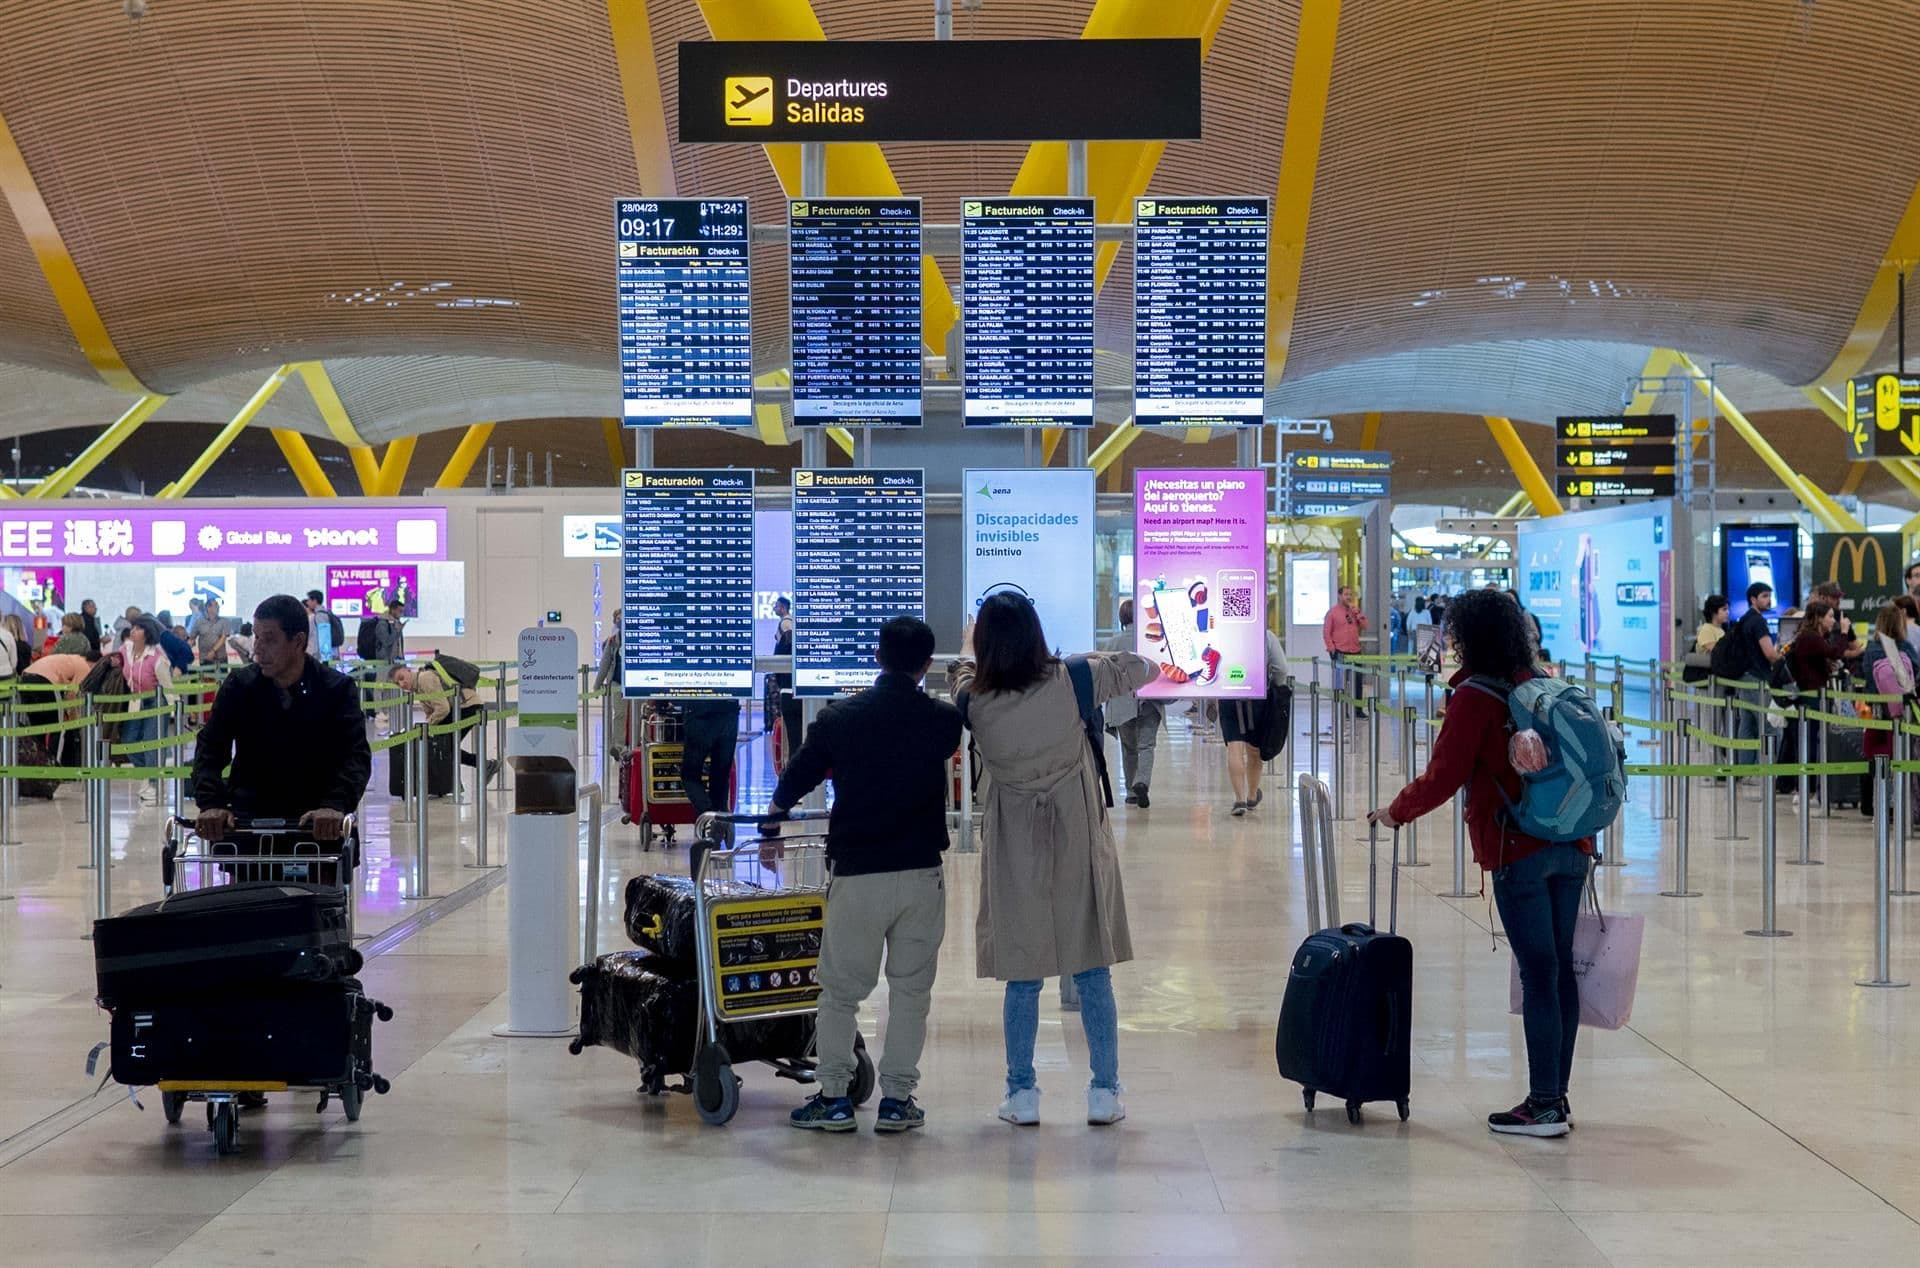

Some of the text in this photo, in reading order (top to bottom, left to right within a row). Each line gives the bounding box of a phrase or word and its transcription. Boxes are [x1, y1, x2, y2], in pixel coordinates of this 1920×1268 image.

[787, 79, 888, 100] Departures
[786, 103, 865, 124] Salidas
[622, 204, 658, 212] 28/04/23
[812, 206, 870, 215] Facturación
[985, 206, 1044, 215] Facturación
[1159, 205, 1217, 214] Facturación
[620, 218, 675, 236] 09:17
[640, 246, 698, 255] Facturación
[646, 477, 703, 486] Facturación
[816, 476, 874, 485] Facturación
[1144, 480, 1199, 490] ¿Necesitas
[1217, 480, 1245, 491] plano
[1144, 491, 1224, 502] del aeropuerto?
[1144, 502, 1216, 514] Aquí lo tienes.
[976, 513, 1078, 527] Discapacidades
[0, 521, 53, 556] EE
[226, 531, 292, 544] Global Blue
[304, 527, 379, 548] planet
[976, 530, 1039, 542] invisibles
[976, 548, 1022, 556] Distintivo
[331, 570, 372, 579] TAX FREE
